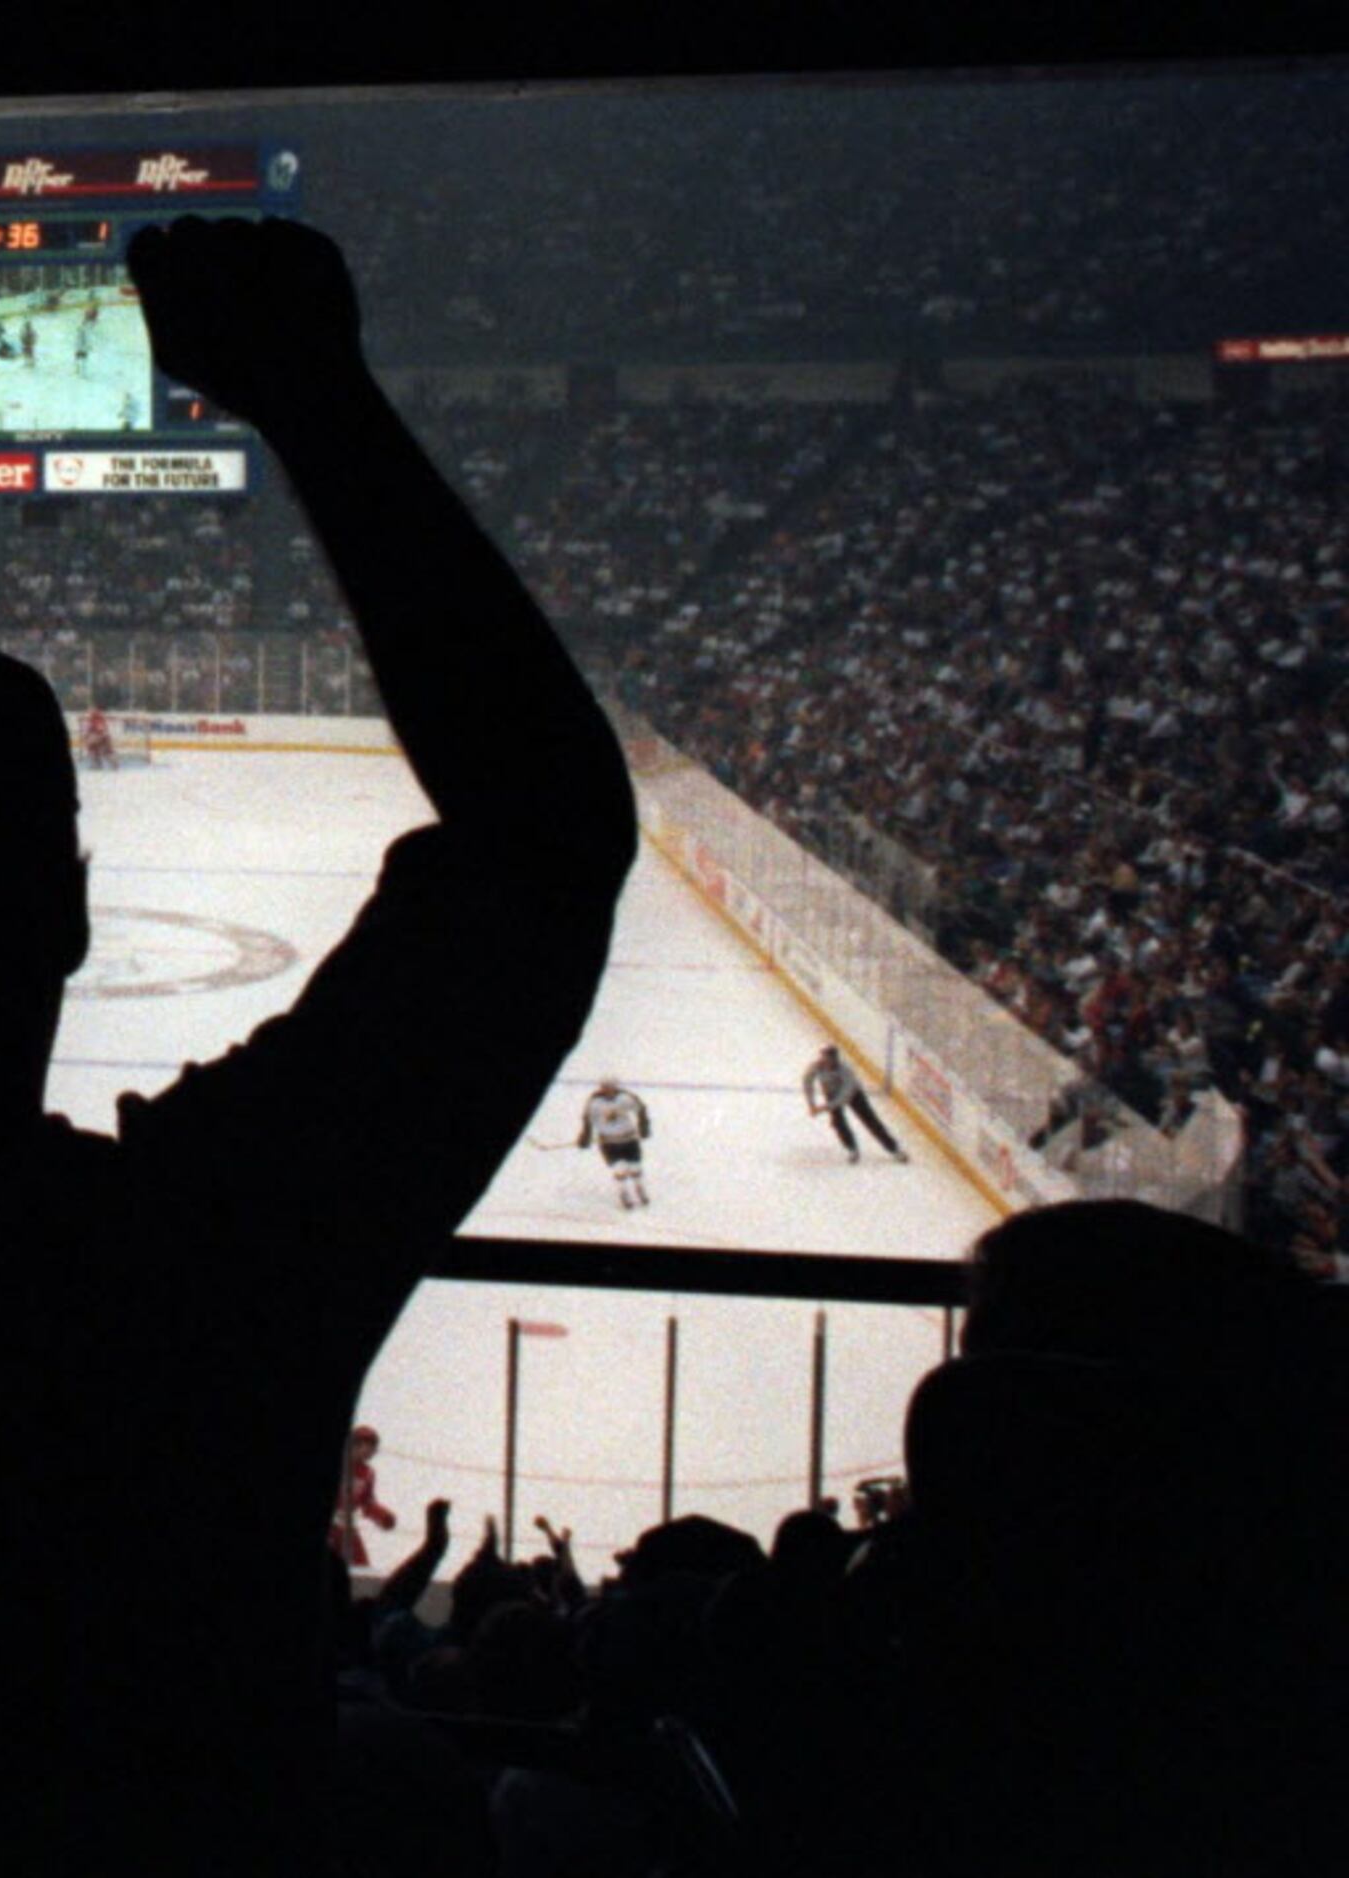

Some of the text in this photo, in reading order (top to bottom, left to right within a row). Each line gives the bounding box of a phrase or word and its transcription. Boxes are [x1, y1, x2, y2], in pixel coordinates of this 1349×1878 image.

[110, 456, 213, 470] THE FORMULA
[103, 472, 130, 487] FOR
[134, 472, 160, 487] THE
